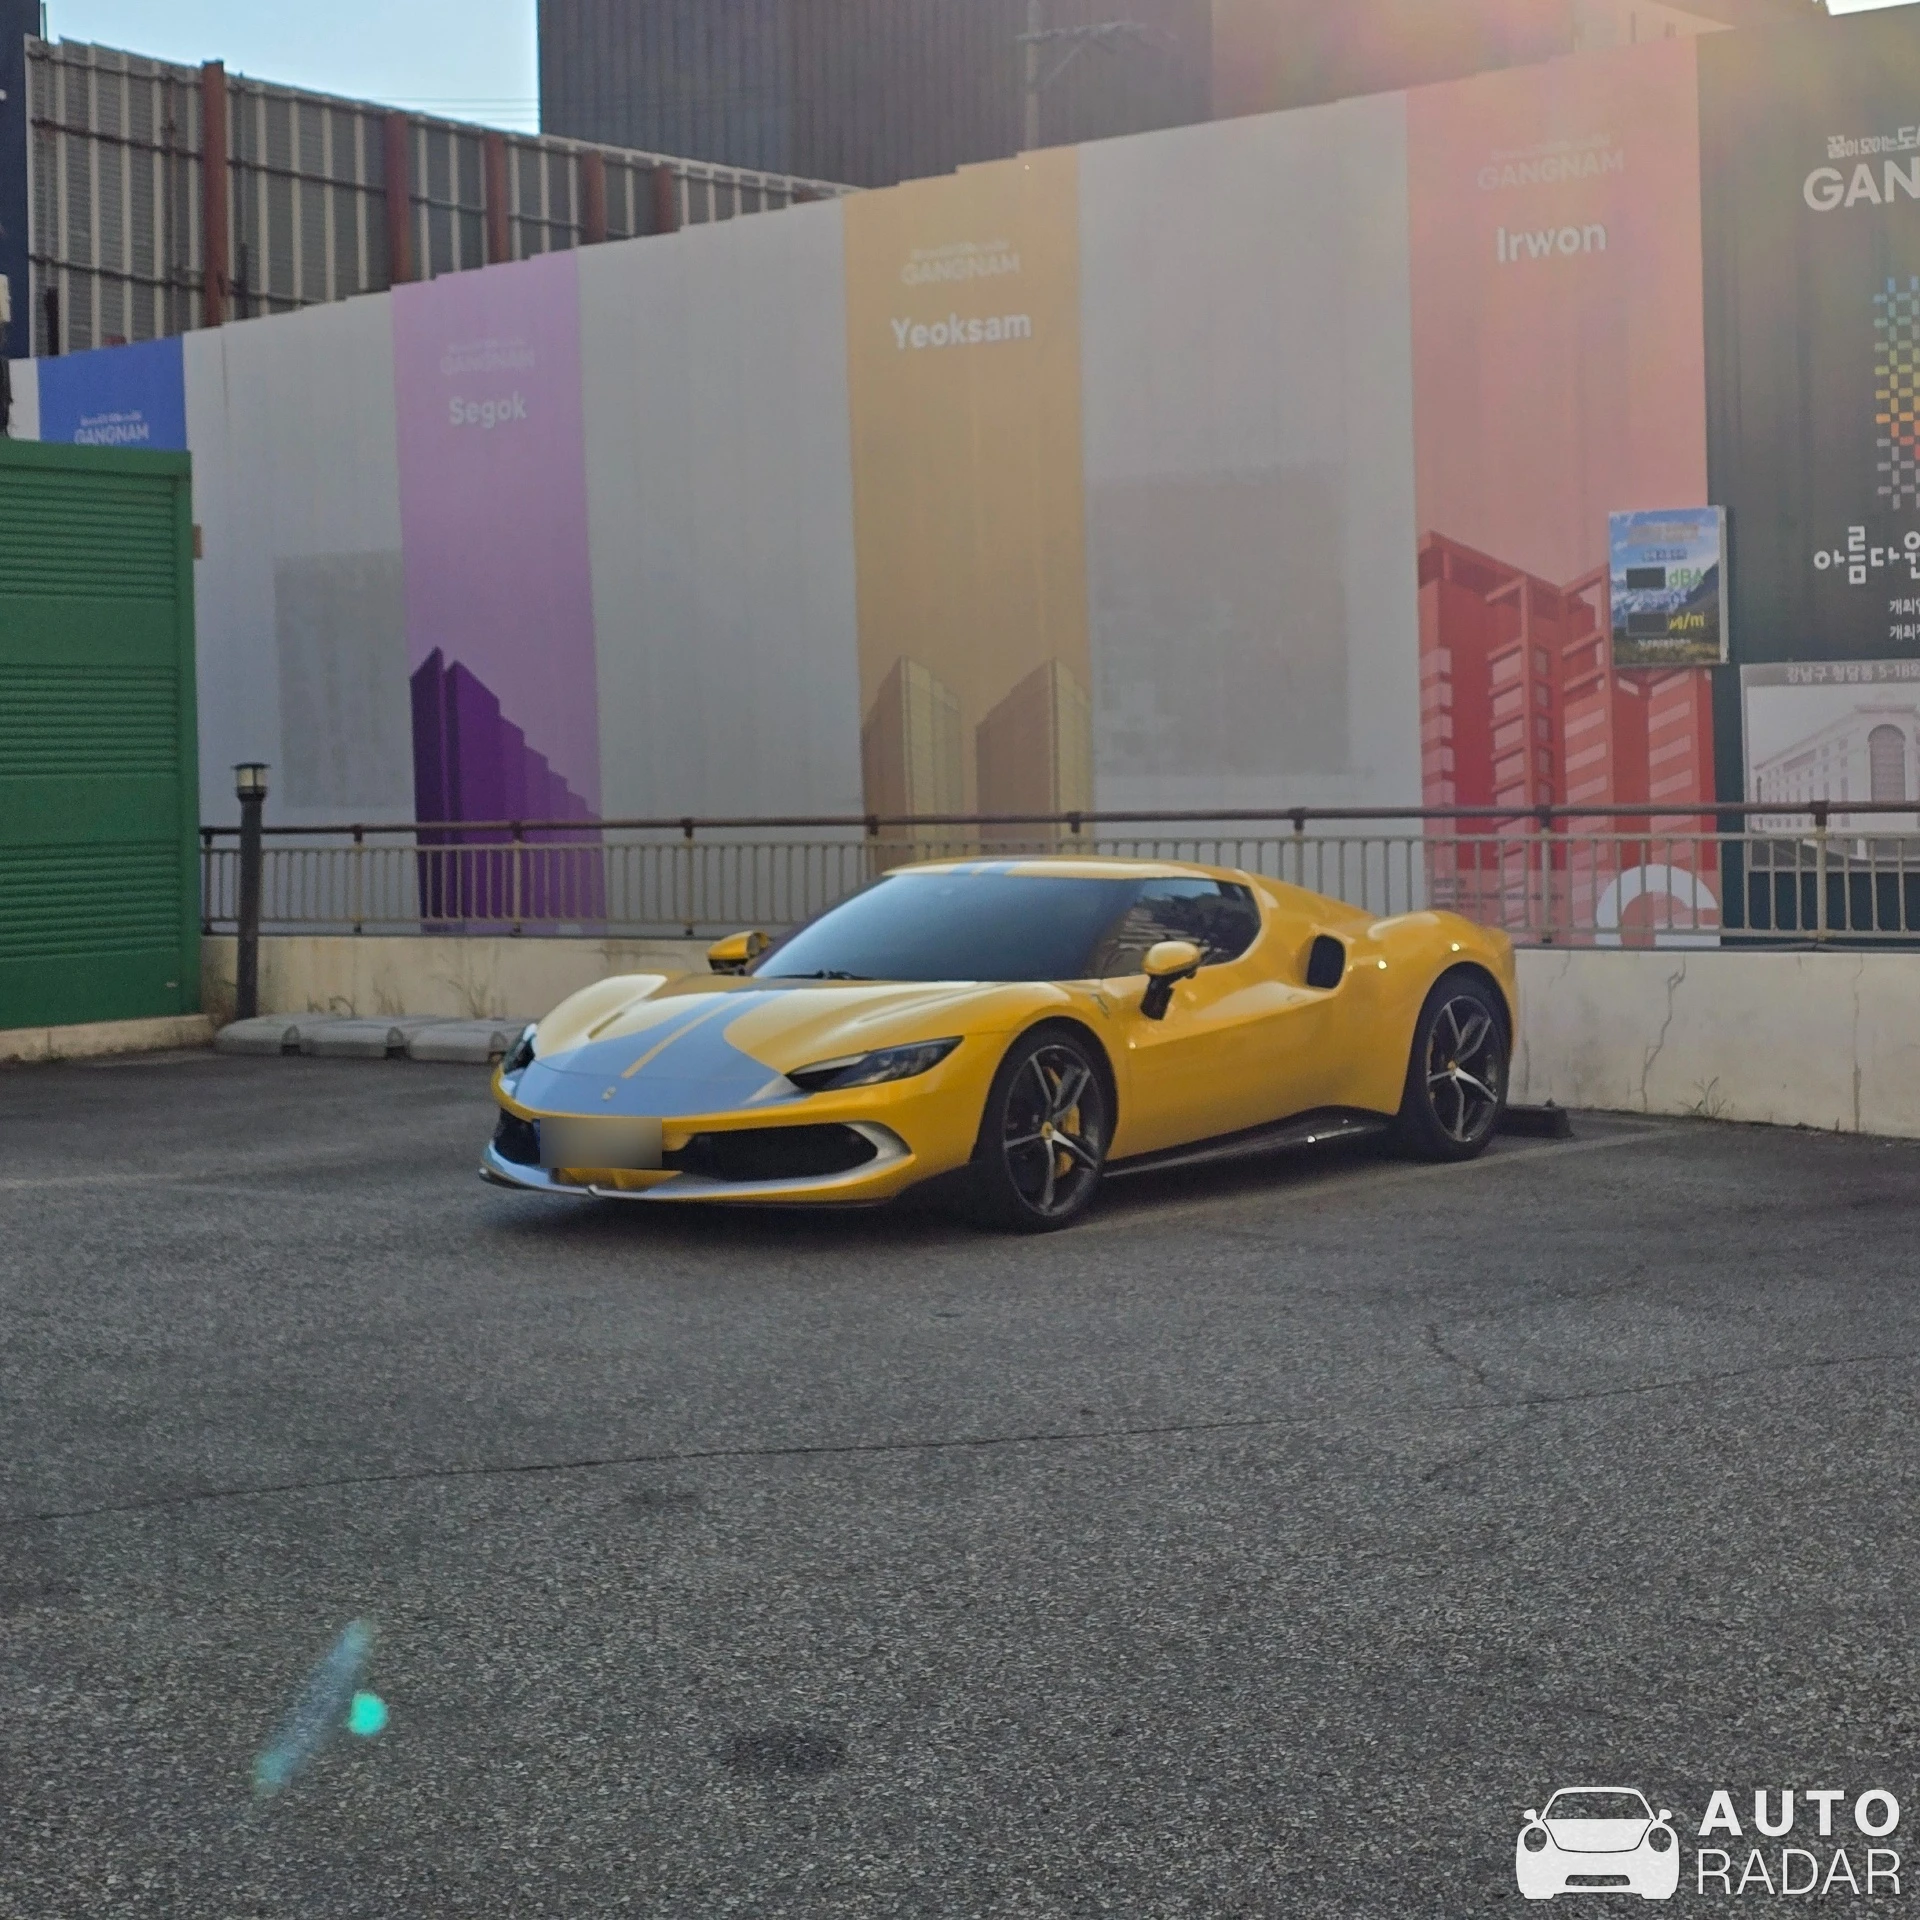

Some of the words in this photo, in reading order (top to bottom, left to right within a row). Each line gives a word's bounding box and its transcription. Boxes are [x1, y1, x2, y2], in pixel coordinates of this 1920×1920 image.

[1897, 125, 1920, 151] 도
[1477, 149, 1624, 190] GANGNAM
[1496, 223, 1607, 263] Irwon
[891, 312, 1032, 350] Yeoksam
[449, 390, 527, 429] Segok
[1668, 568, 1704, 588] dBA
